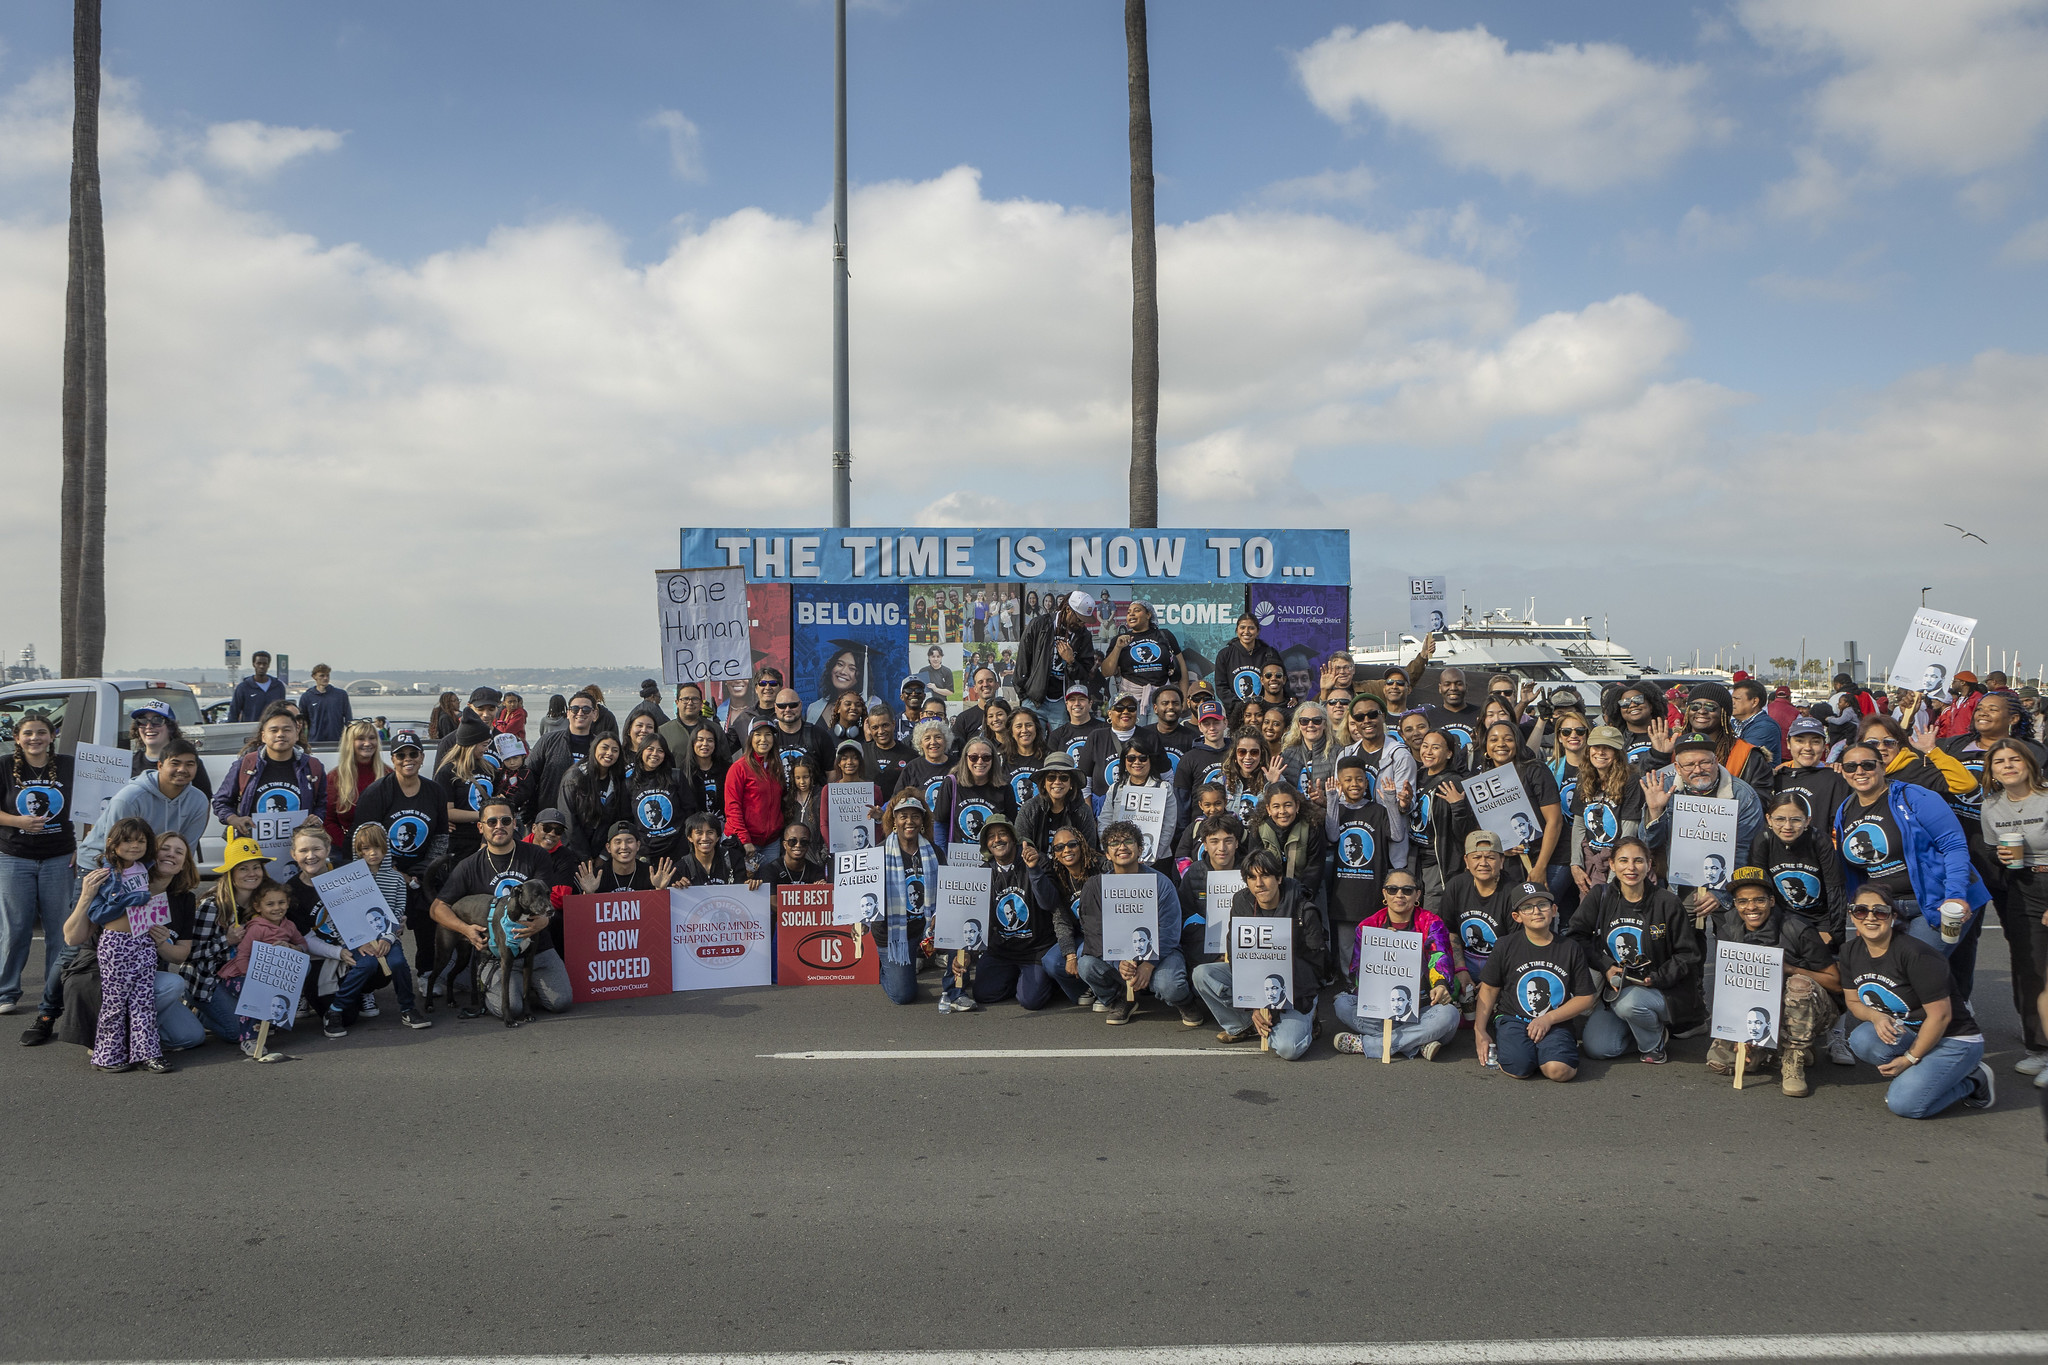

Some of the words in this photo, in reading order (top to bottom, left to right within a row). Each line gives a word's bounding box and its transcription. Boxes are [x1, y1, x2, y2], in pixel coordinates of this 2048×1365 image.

[716, 537, 820, 578] THE
[841, 536, 976, 578] TIME
[998, 536, 1047, 579] IS
[1068, 536, 1186, 579] NOW
[798, 602, 907, 626] BELONG.
[1153, 604, 1239, 625] ECOME.
[1278, 605, 1295, 614] SAN
[1296, 605, 1324, 616] DIEGO
[666, 611, 744, 642] Human
[1278, 616, 1306, 625] Community
[1306, 617, 1324, 626] College
[1324, 617, 1342, 625] District
[1916, 628, 1958, 647] WHERE
[1919, 642, 1924, 651] I
[1924, 644, 1944, 656] AM
[676, 648, 741, 682] Race
[80, 751, 130, 768] BECOME...
[77, 770, 125, 785] INSPIRATION
[257, 784, 268, 793] THE
[291, 784, 301, 794] NOW
[831, 786, 872, 796] BECOME...
[1800, 788, 1813, 796] NOW
[838, 805, 862, 814] WANT
[1477, 792, 1522, 814] CONFIDENT
[1676, 801, 1734, 817] BECOME...
[420, 812, 431, 821] NOW
[840, 814, 848, 822] TO
[1132, 814, 1160, 822] EXAMPLE
[1698, 818, 1707, 828] A
[1364, 823, 1375, 832] NOW
[1679, 828, 1727, 842] LEADER
[319, 872, 370, 892] BECOME...
[516, 872, 528, 880] NOW
[839, 877, 848, 886] A
[849, 874, 879, 885] HERO
[342, 886, 354, 895] AN
[940, 880, 943, 890] I
[945, 880, 988, 891] BELONG
[1208, 885, 1212, 894] I
[328, 886, 375, 908] INSPIRATION
[781, 890, 802, 906] THE
[803, 890, 829, 905] BEST
[949, 894, 976, 905] HERE
[1104, 889, 1108, 898] I
[1110, 889, 1154, 899] BELONG
[310, 904, 319, 916] THE
[595, 900, 640, 923] LEARN
[697, 902, 715, 917] SAN
[716, 901, 742, 916] DIEGO
[1115, 903, 1144, 914] HERE
[781, 910, 818, 926] SOCIAL
[1488, 916, 1498, 927] NOW
[1610, 919, 1619, 927] THE
[676, 922, 726, 933] INSPIRING
[598, 929, 640, 952] GROW
[673, 933, 718, 945] SHAPING
[720, 931, 765, 942] FUTURES
[1364, 935, 1369, 946] I
[1370, 936, 1418, 950] BELONG
[258, 944, 303, 964] BELONG
[820, 939, 842, 963] US
[1250, 952, 1286, 961] EXAMPLE
[1384, 951, 1397, 962] IN
[1720, 948, 1780, 967] BECOME...
[256, 952, 302, 973] BELONG
[588, 956, 650, 982] SUCCEED
[253, 961, 298, 983] BELONG
[1365, 963, 1414, 978] SCHOOL
[1516, 963, 1528, 973] THE
[1554, 964, 1568, 977] NOW
[1725, 963, 1735, 973] A
[1736, 964, 1770, 978] ROLE
[251, 970, 296, 994] BELONG
[1725, 974, 1770, 992] MODEL
